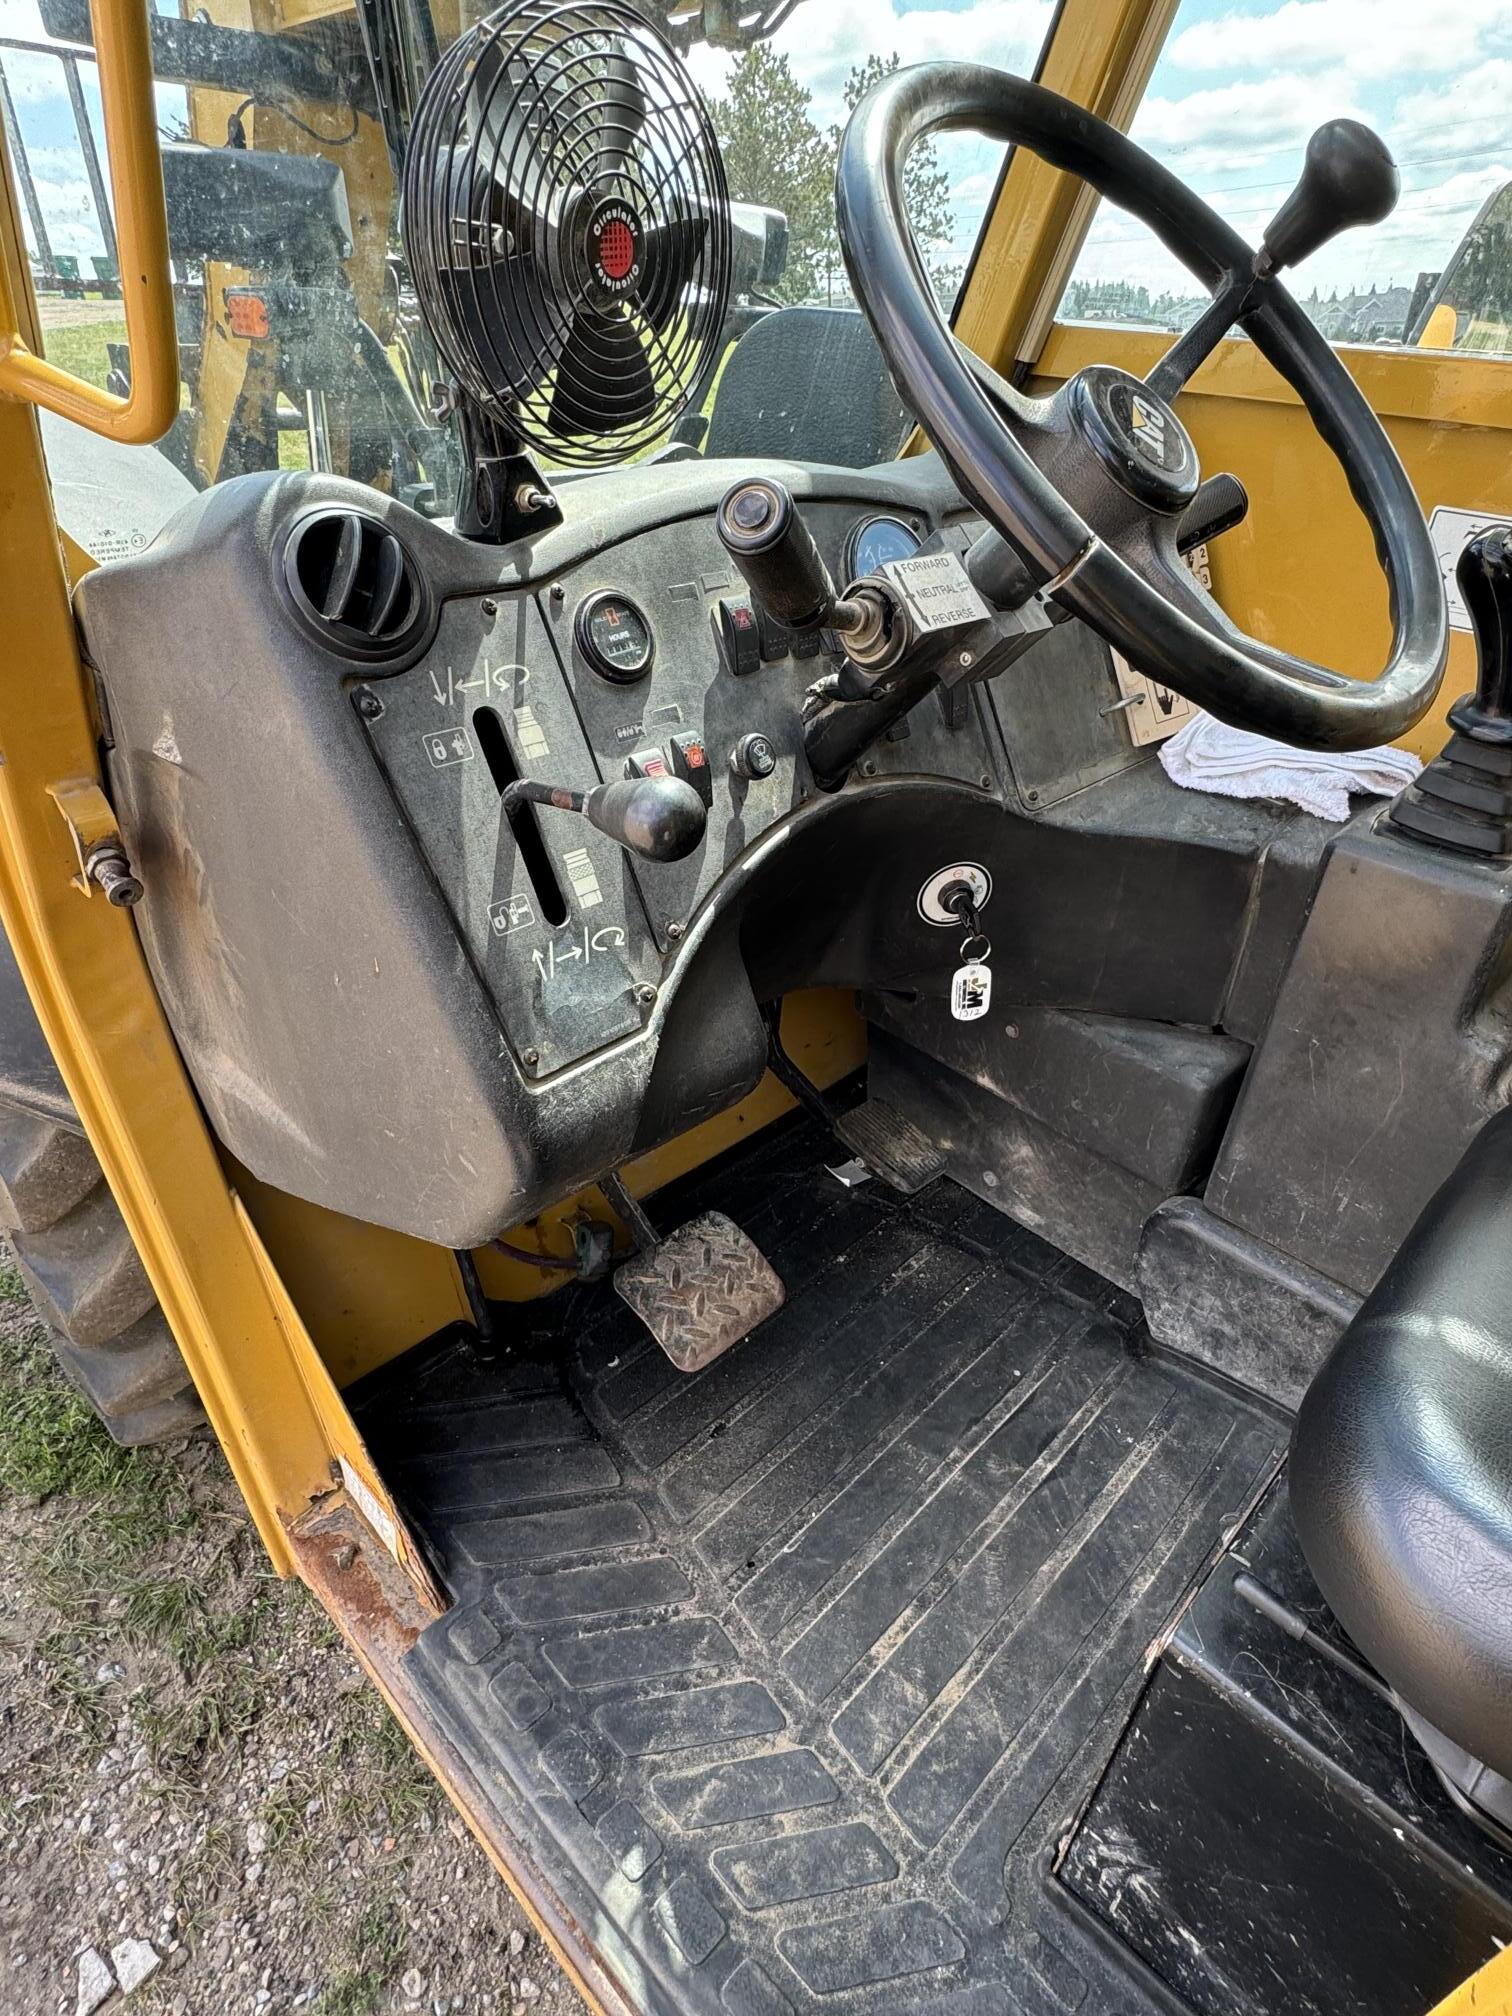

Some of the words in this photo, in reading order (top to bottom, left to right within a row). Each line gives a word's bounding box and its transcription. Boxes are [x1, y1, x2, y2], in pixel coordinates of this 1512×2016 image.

[594, 206, 638, 236] Circulator
[595, 264, 639, 292] Circulator
[1132, 395, 1164, 459] CAT
[1199, 547, 1206, 558] 2
[900, 557, 950, 574] FORWARD
[1202, 574, 1209, 584] 3
[916, 582, 959, 600] NEUTRAL
[931, 607, 976, 625] REVERSE
[608, 630, 630, 642] HOURS
